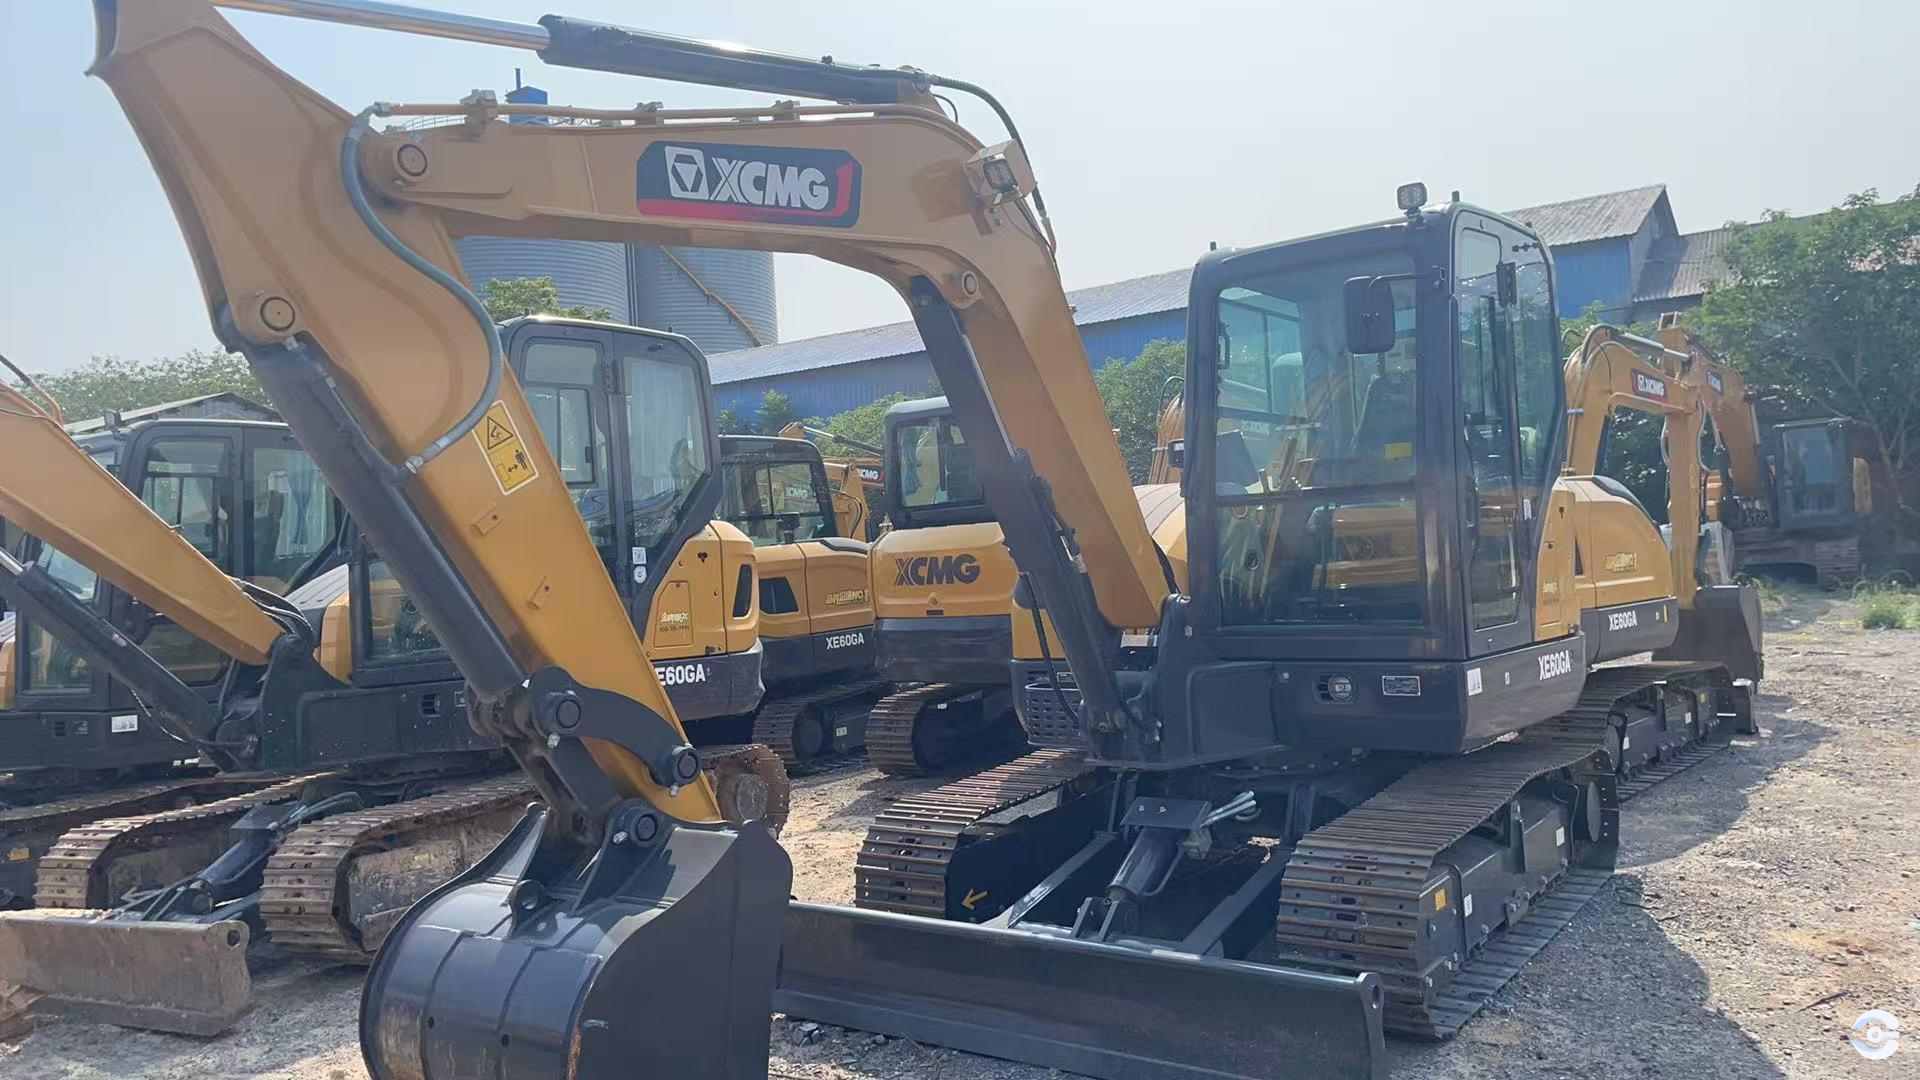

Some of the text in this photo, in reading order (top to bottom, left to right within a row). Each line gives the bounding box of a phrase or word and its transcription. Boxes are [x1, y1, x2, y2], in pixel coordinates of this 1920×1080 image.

[710, 156, 829, 210] XCMG
[895, 554, 980, 585] XCMG
[1608, 610, 1638, 631] XE60GA
[825, 632, 865, 649] XE60GA
[655, 663, 706, 686] E60GA
[1538, 650, 1572, 681] XE60GA
